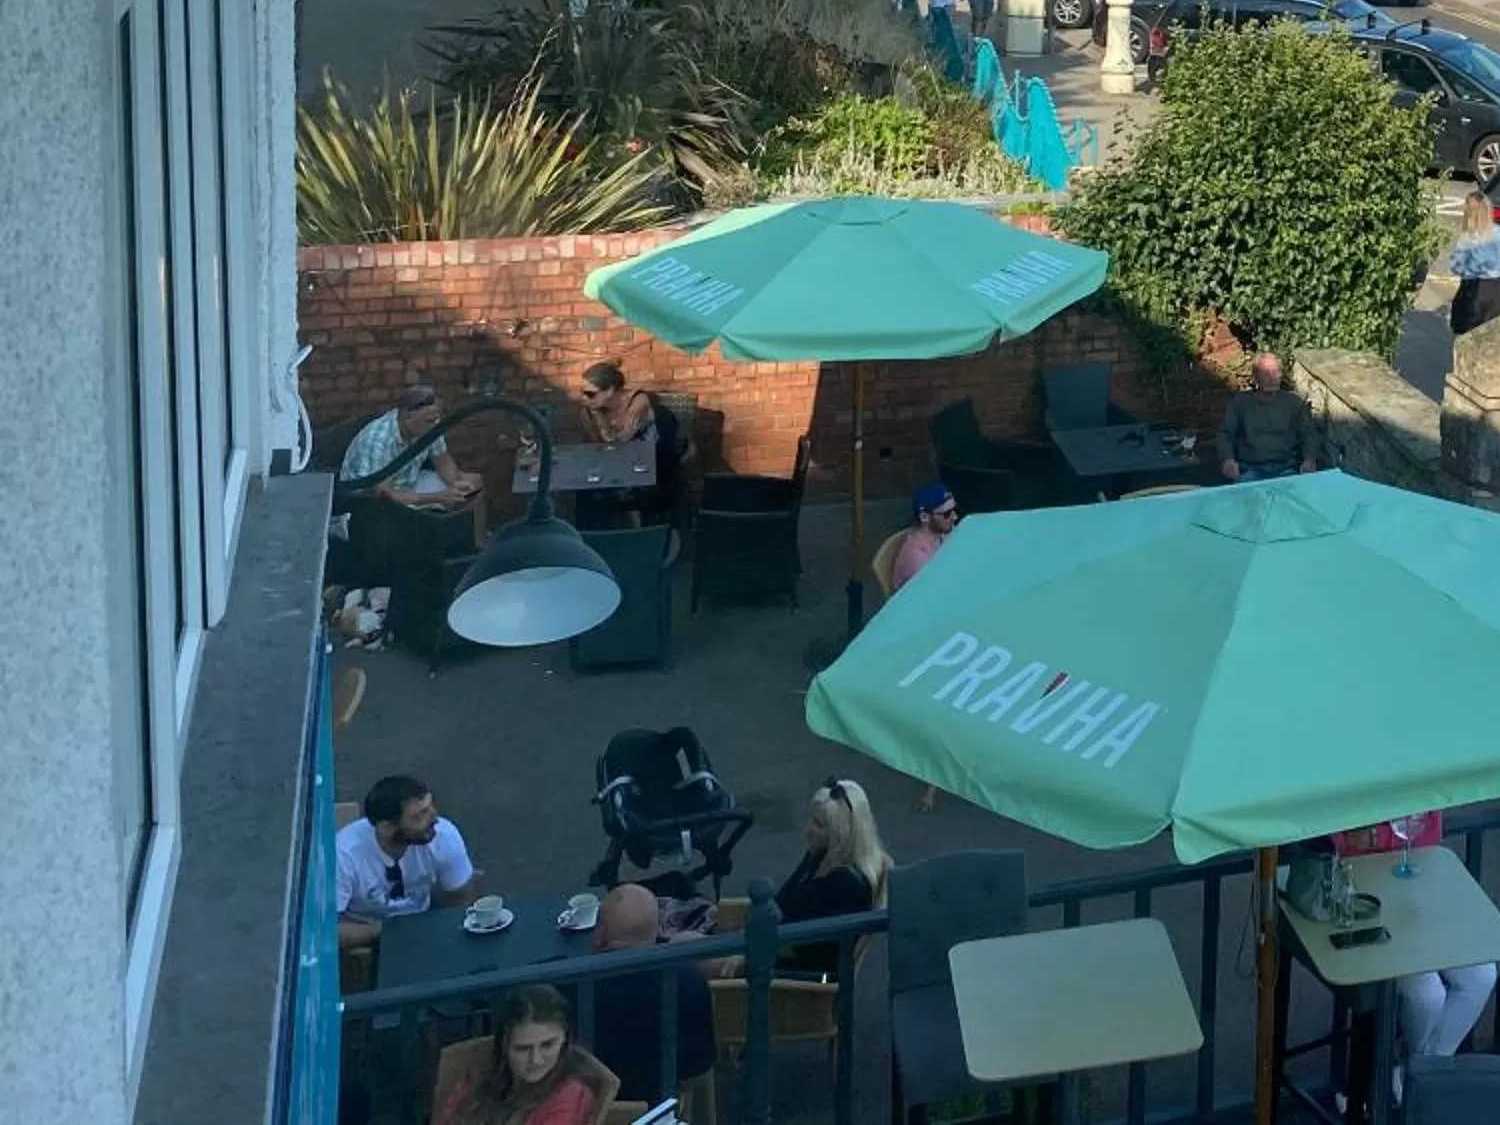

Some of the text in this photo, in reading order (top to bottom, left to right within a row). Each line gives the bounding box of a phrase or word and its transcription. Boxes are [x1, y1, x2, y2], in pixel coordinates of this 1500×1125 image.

[630, 256, 745, 316] PRAVHA
[970, 251, 1073, 305] PRAVHA
[897, 630, 1162, 769] PRAVHA
